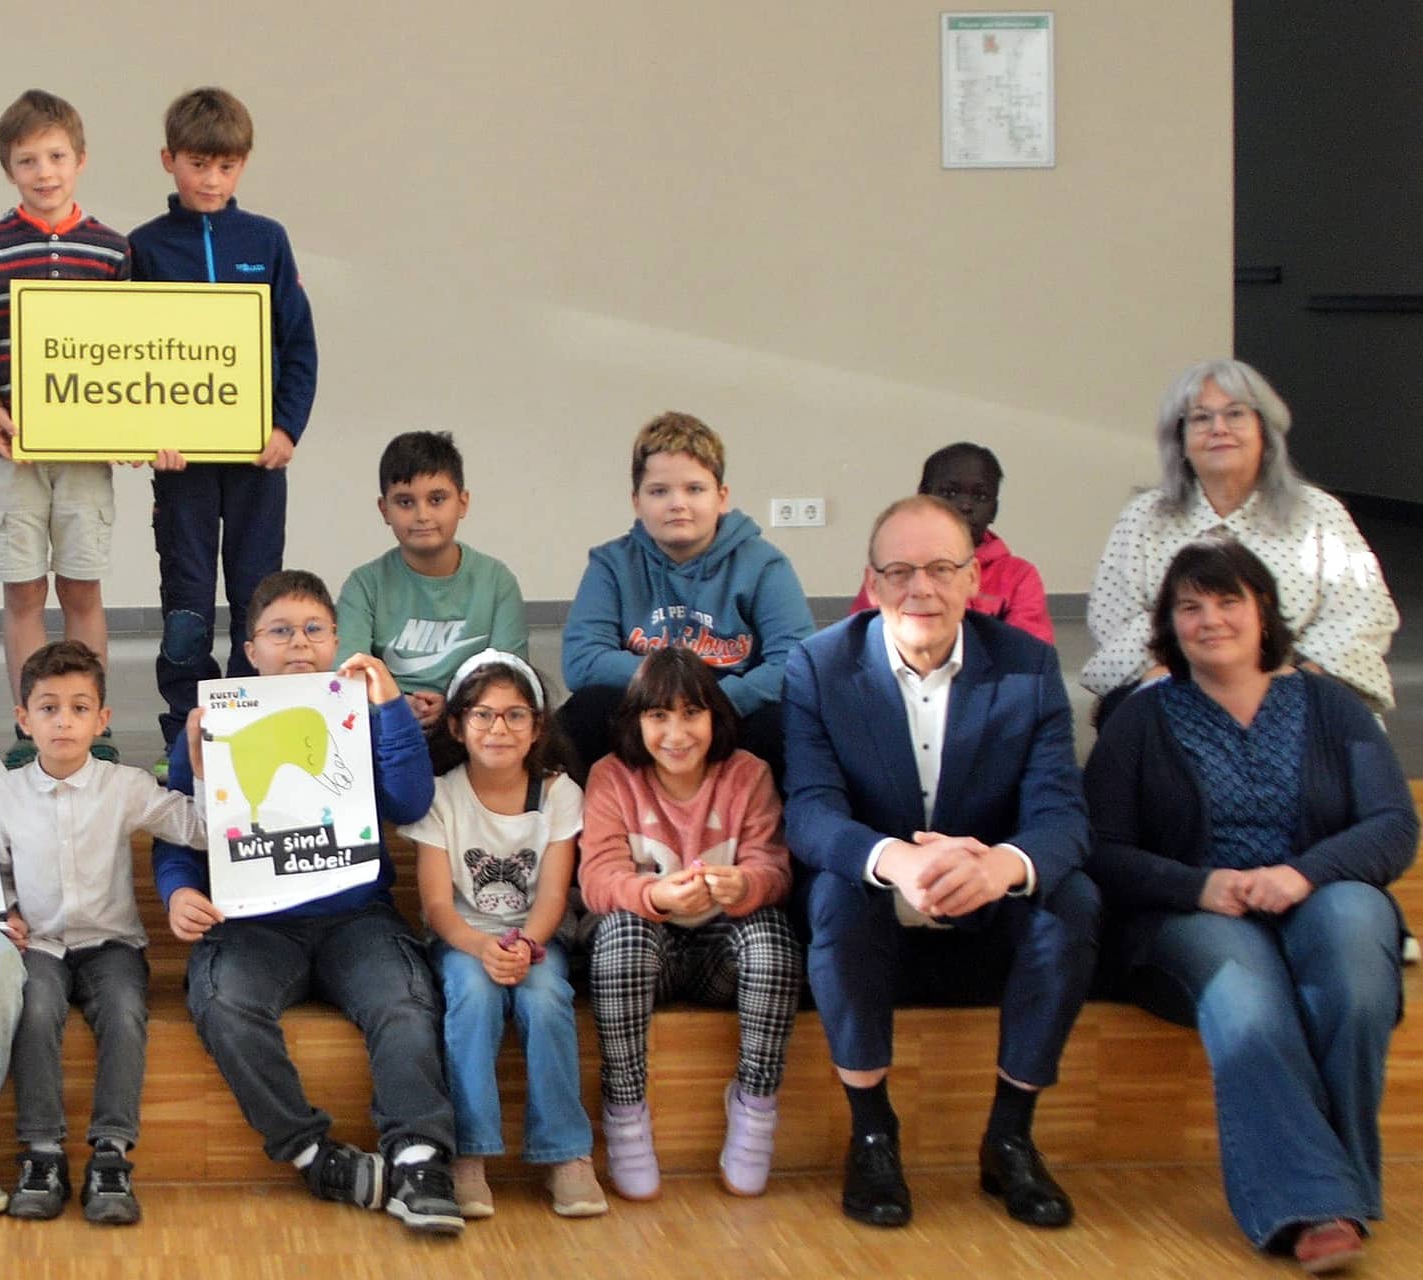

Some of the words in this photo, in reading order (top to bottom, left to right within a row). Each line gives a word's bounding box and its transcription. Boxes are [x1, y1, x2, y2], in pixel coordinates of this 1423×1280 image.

[44, 337, 237, 367] Bürgerstiftung
[45, 372, 238, 405] Meschede
[396, 618, 467, 653] NIKE
[238, 837, 274, 857] Wir
[283, 831, 329, 851] sind
[284, 849, 352, 873] dabei!
